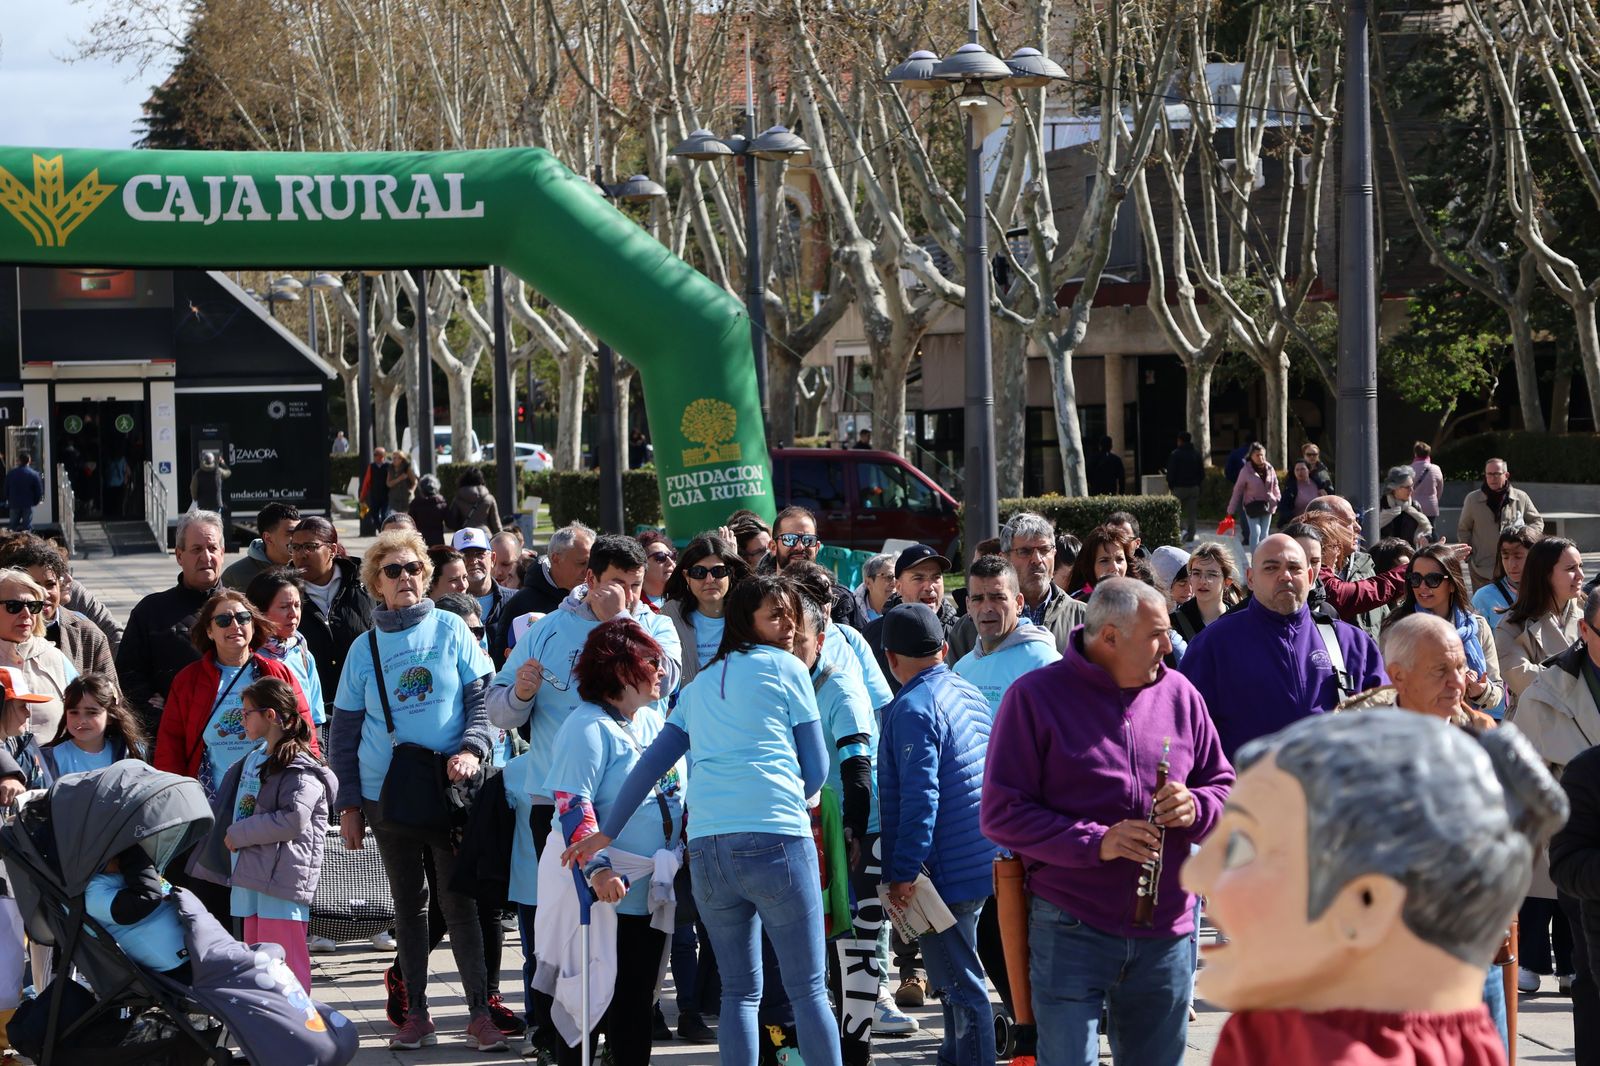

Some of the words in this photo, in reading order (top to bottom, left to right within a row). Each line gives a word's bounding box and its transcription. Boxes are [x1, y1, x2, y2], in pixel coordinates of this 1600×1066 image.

[122, 174, 271, 225] CAJA
[275, 173, 484, 221] RURAL
[236, 448, 278, 459] ZAMORA
[230, 490, 268, 499] undación
[668, 490, 706, 507] CAJA
[710, 481, 766, 501] RURAL
